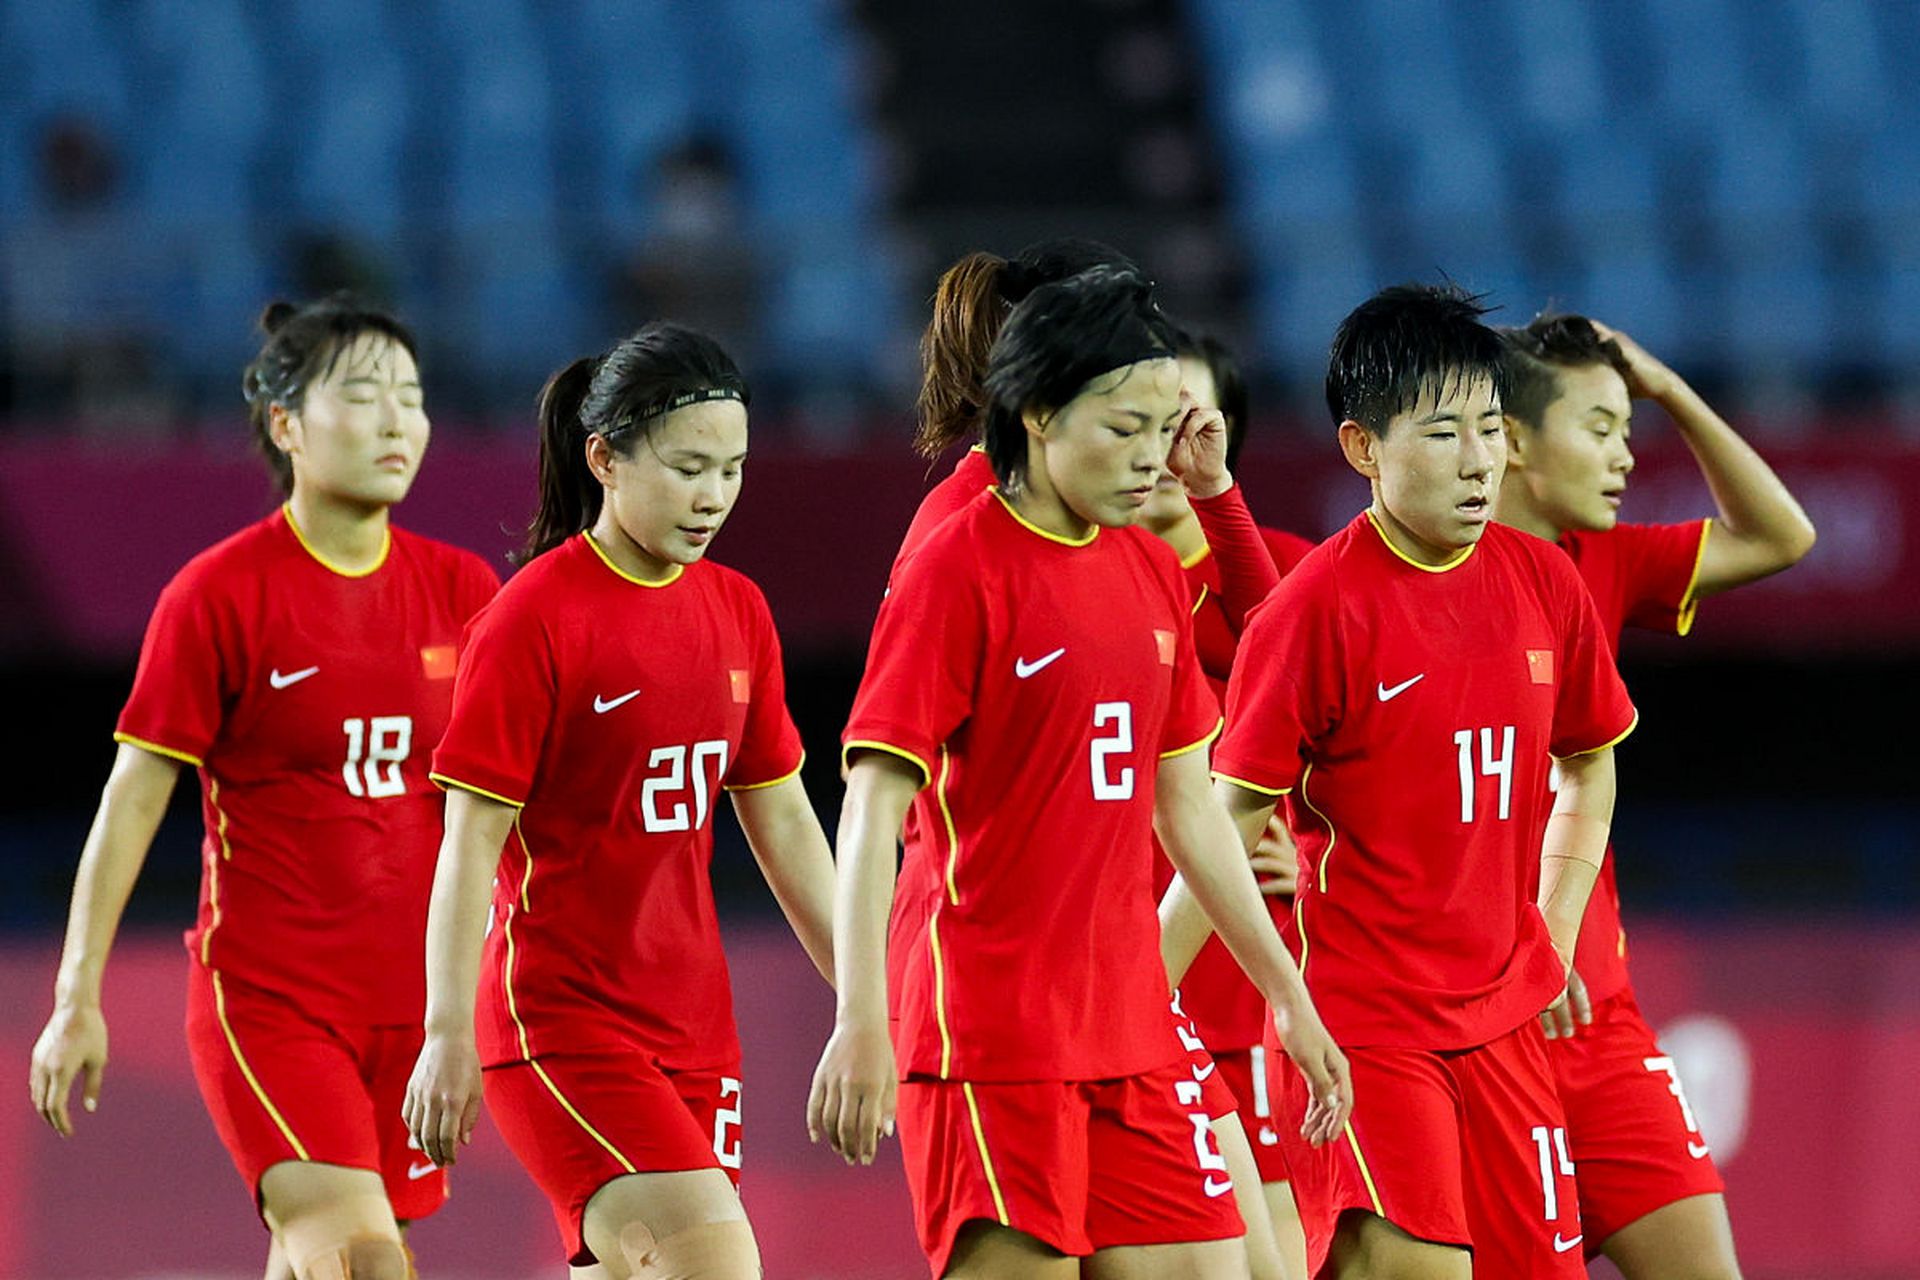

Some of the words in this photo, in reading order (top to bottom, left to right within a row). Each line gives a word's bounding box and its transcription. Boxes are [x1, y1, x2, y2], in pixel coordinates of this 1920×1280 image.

[343, 716, 412, 798] 18
[1090, 701, 1134, 801] 2
[1454, 726, 1515, 823] 14
